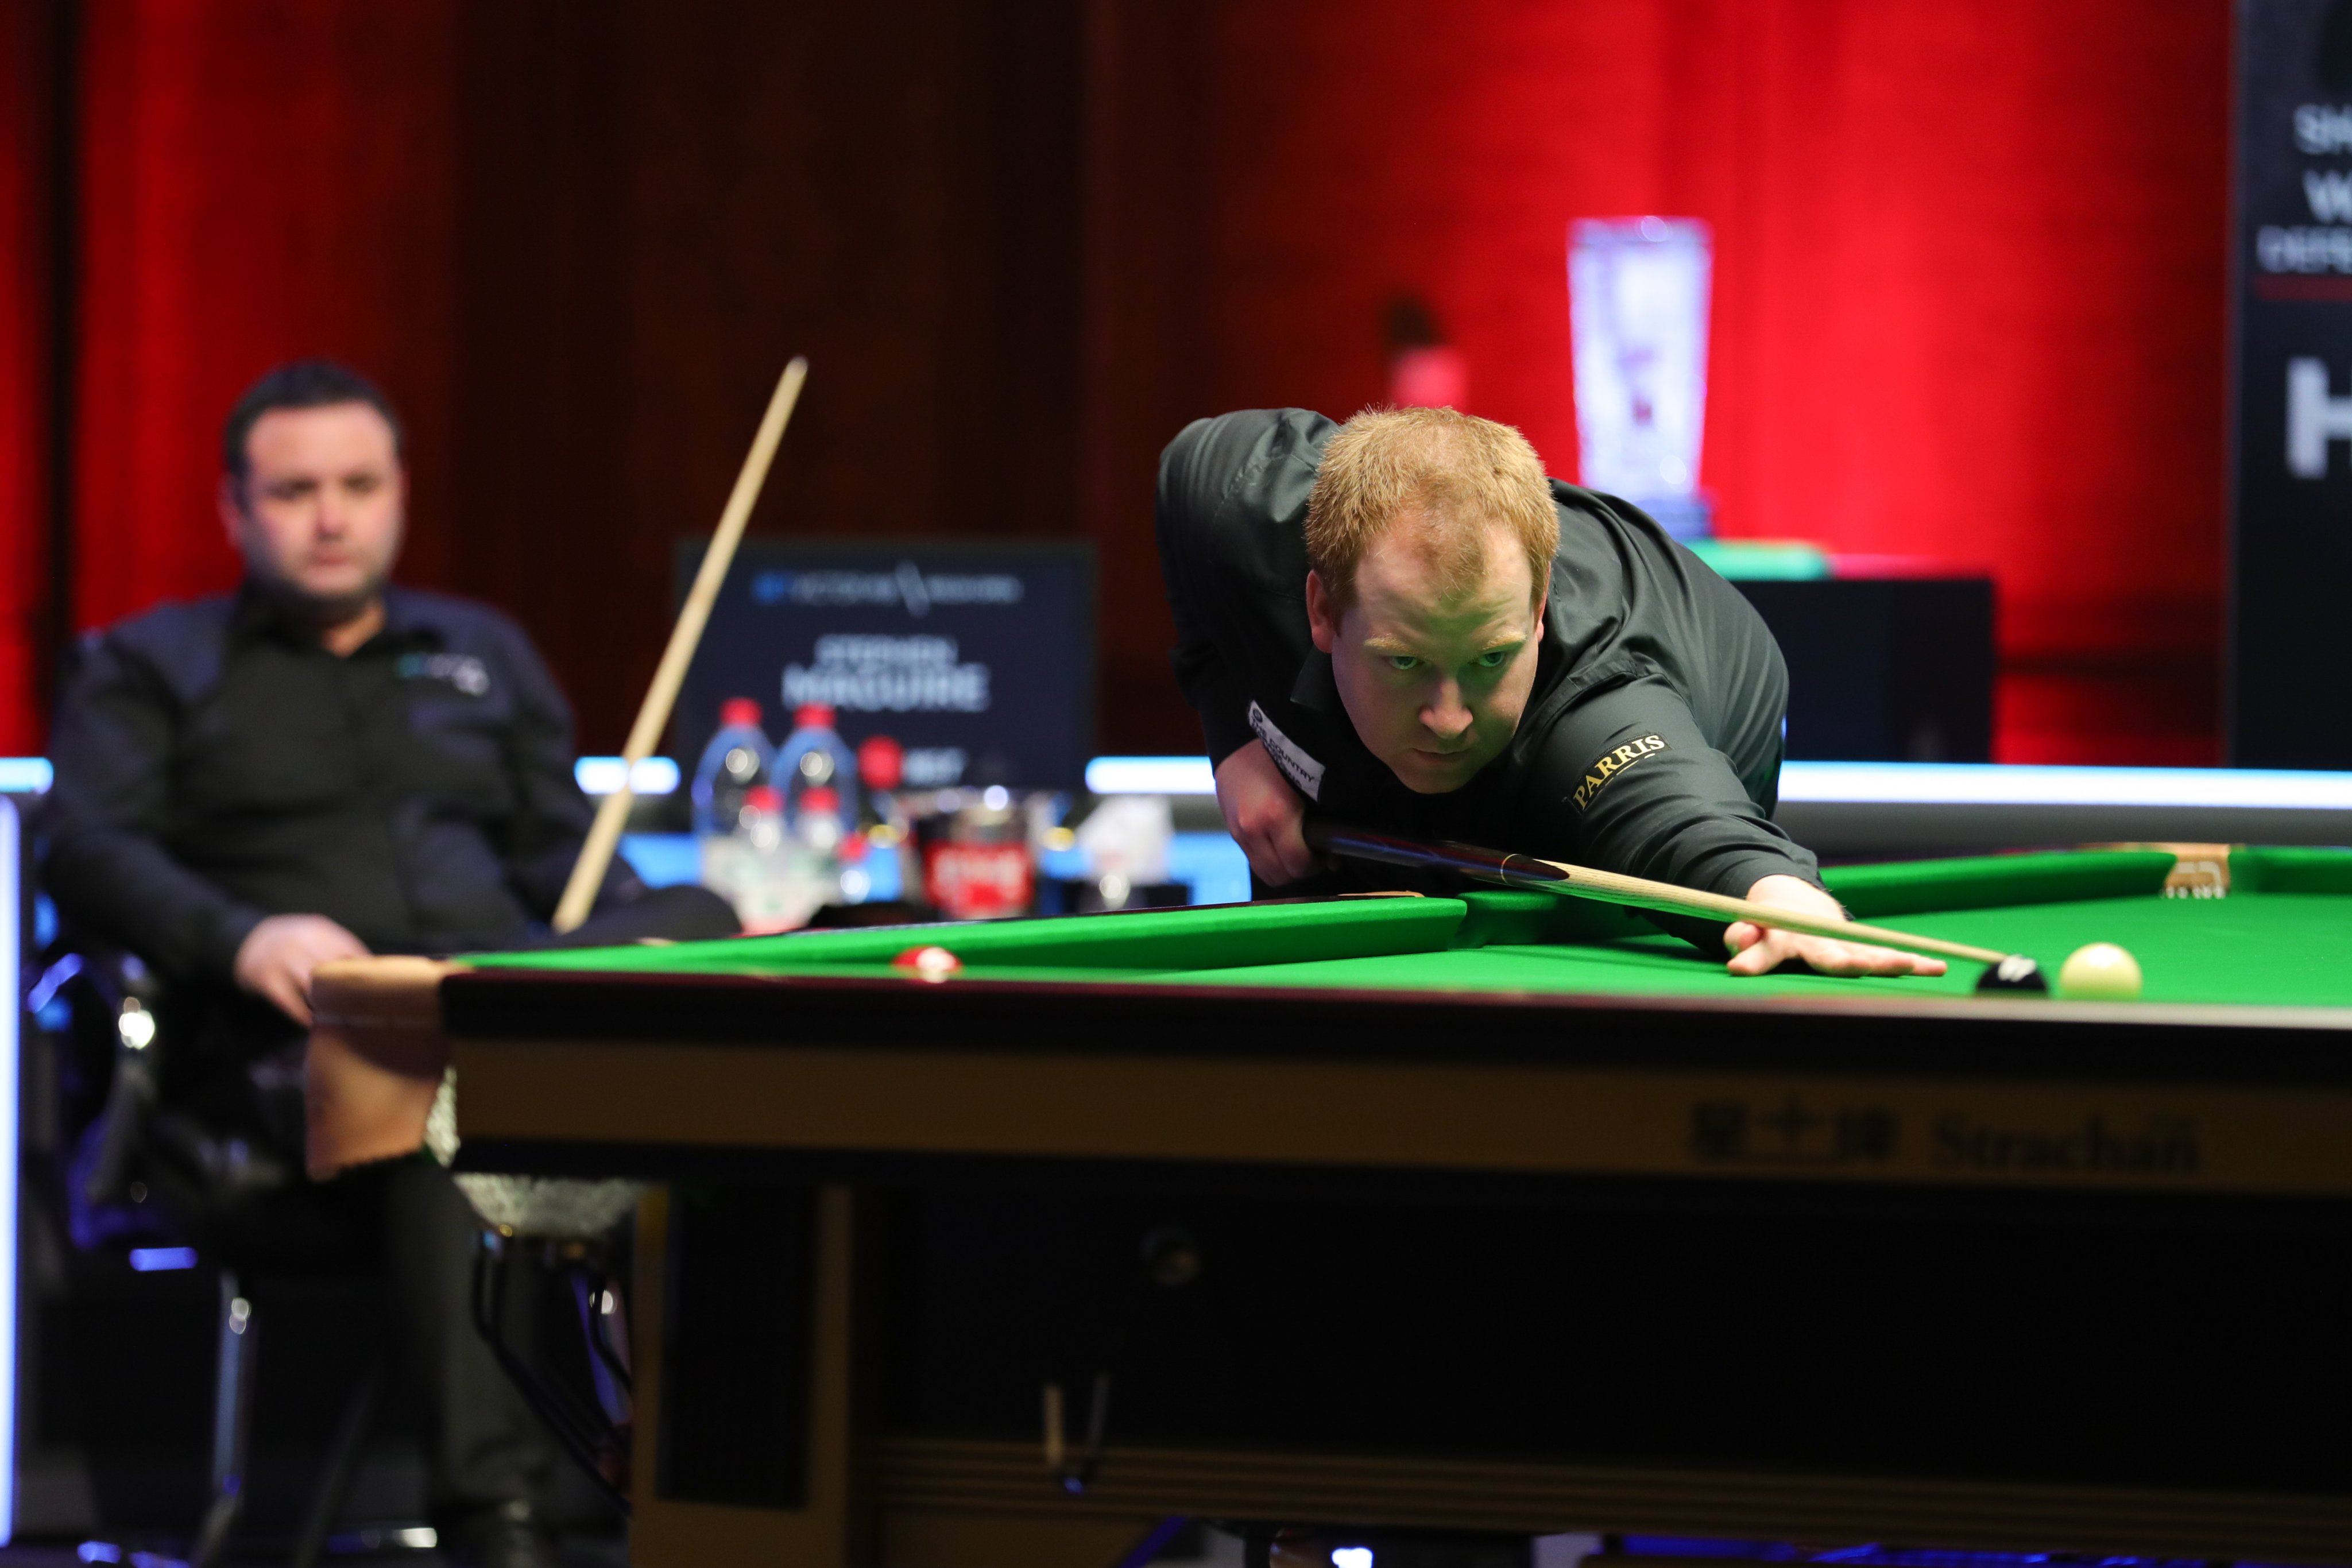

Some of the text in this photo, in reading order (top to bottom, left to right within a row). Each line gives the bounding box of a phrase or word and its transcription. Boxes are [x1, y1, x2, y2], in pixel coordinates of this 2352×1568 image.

[782, 664, 990, 712] MAGUIRE
[1269, 738, 1314, 783] COUNTRY
[1573, 735, 1665, 811] PARRIS
[1929, 1108, 2200, 1175] Strachan
